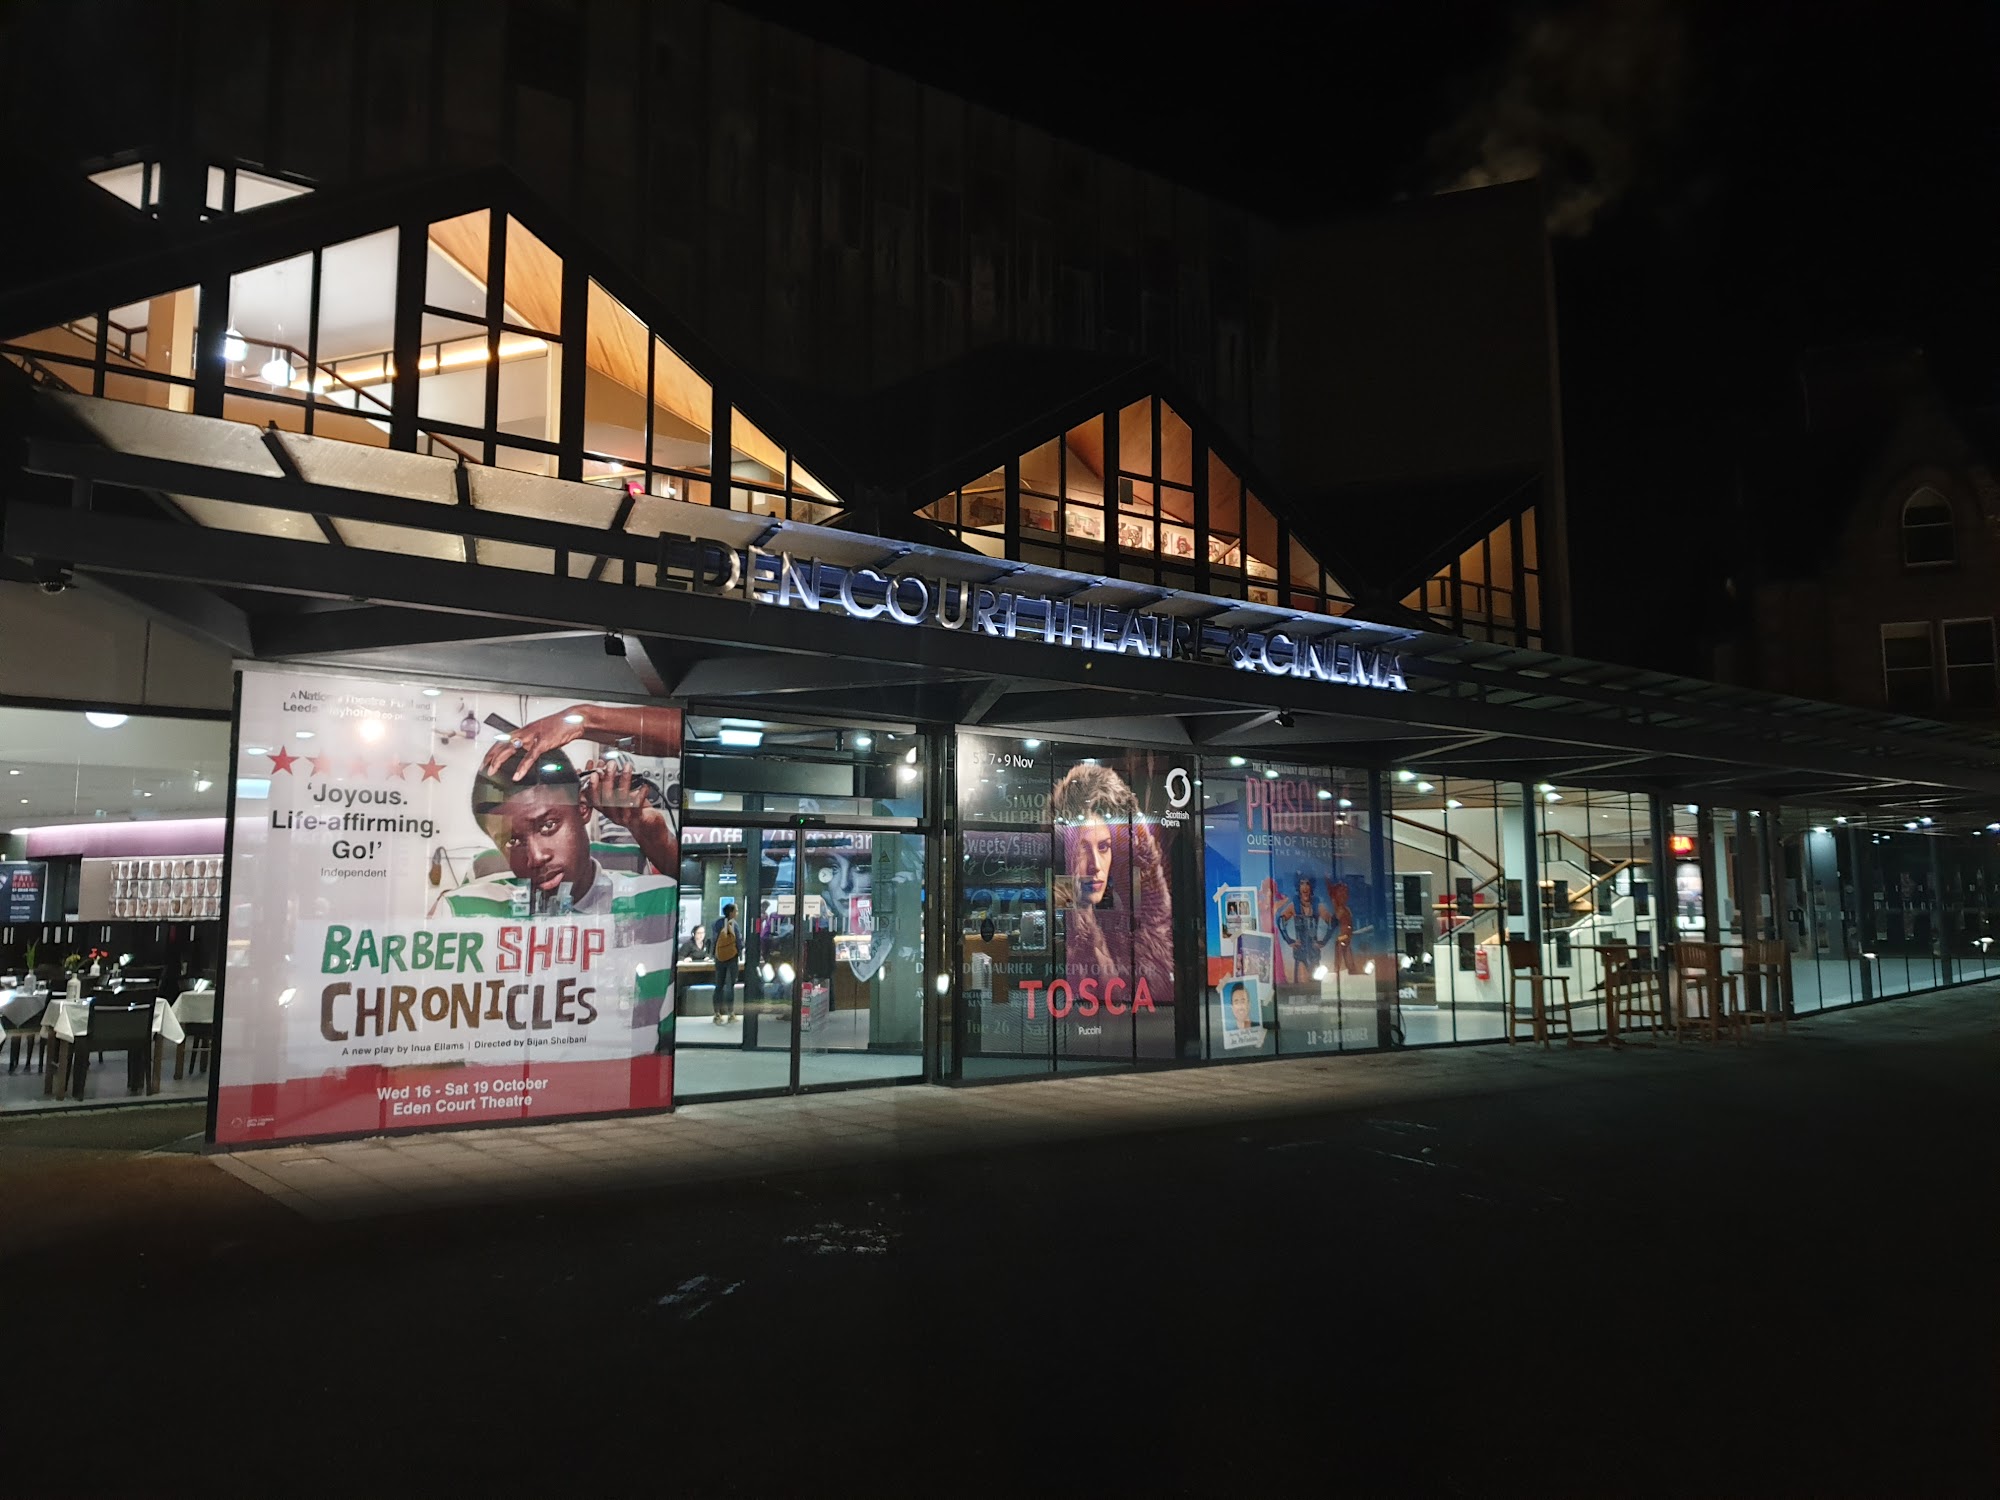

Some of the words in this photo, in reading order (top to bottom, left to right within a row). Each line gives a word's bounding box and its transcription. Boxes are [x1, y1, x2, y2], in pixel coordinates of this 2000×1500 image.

[656, 531, 821, 610] EDEN
[840, 564, 1025, 638] COURT
[1040, 594, 1216, 662] THEATRE
[1226, 624, 1257, 671] &
[1260, 629, 1409, 691] CINEMA
[290, 691, 297, 699] A
[283, 702, 319, 713] Leeds
[989, 753, 996, 765] 7
[1004, 755, 1011, 766] 9
[1013, 756, 1035, 768] Nov
[1165, 809, 1190, 820] Scottish
[272, 810, 440, 838] Life-affirming.
[1160, 817, 1181, 828] Opera
[1247, 834, 1281, 846] QUEEN
[1283, 836, 1297, 846] OF
[1301, 836, 1318, 848] THE
[320, 867, 387, 879] Independent
[321, 924, 485, 975] BARBER
[496, 925, 605, 976] SHOP
[1018, 976, 1157, 1020] TOSCA
[320, 977, 599, 1041] CHRONICLES
[1078, 1026, 1102, 1036] Puccini
[1333, 1027, 1369, 1043] NVEMBER
[342, 1047, 349, 1056] A
[374, 1045, 394, 1056] play
[397, 1044, 408, 1054] by
[411, 1044, 431, 1052] Inua
[434, 1042, 464, 1051] Ellams
[474, 1039, 511, 1049] Directed
[513, 1039, 525, 1047] by
[526, 1037, 549, 1047] Bijan
[551, 1036, 587, 1045] Sheibani
[377, 1086, 410, 1100] Wed
[415, 1084, 431, 1098] 16
[445, 1082, 469, 1096] Sat
[473, 1080, 489, 1094] 19
[493, 1077, 549, 1092] October
[393, 1100, 431, 1116] Eden
[436, 1097, 476, 1112] Court
[480, 1093, 533, 1109] Theatre
